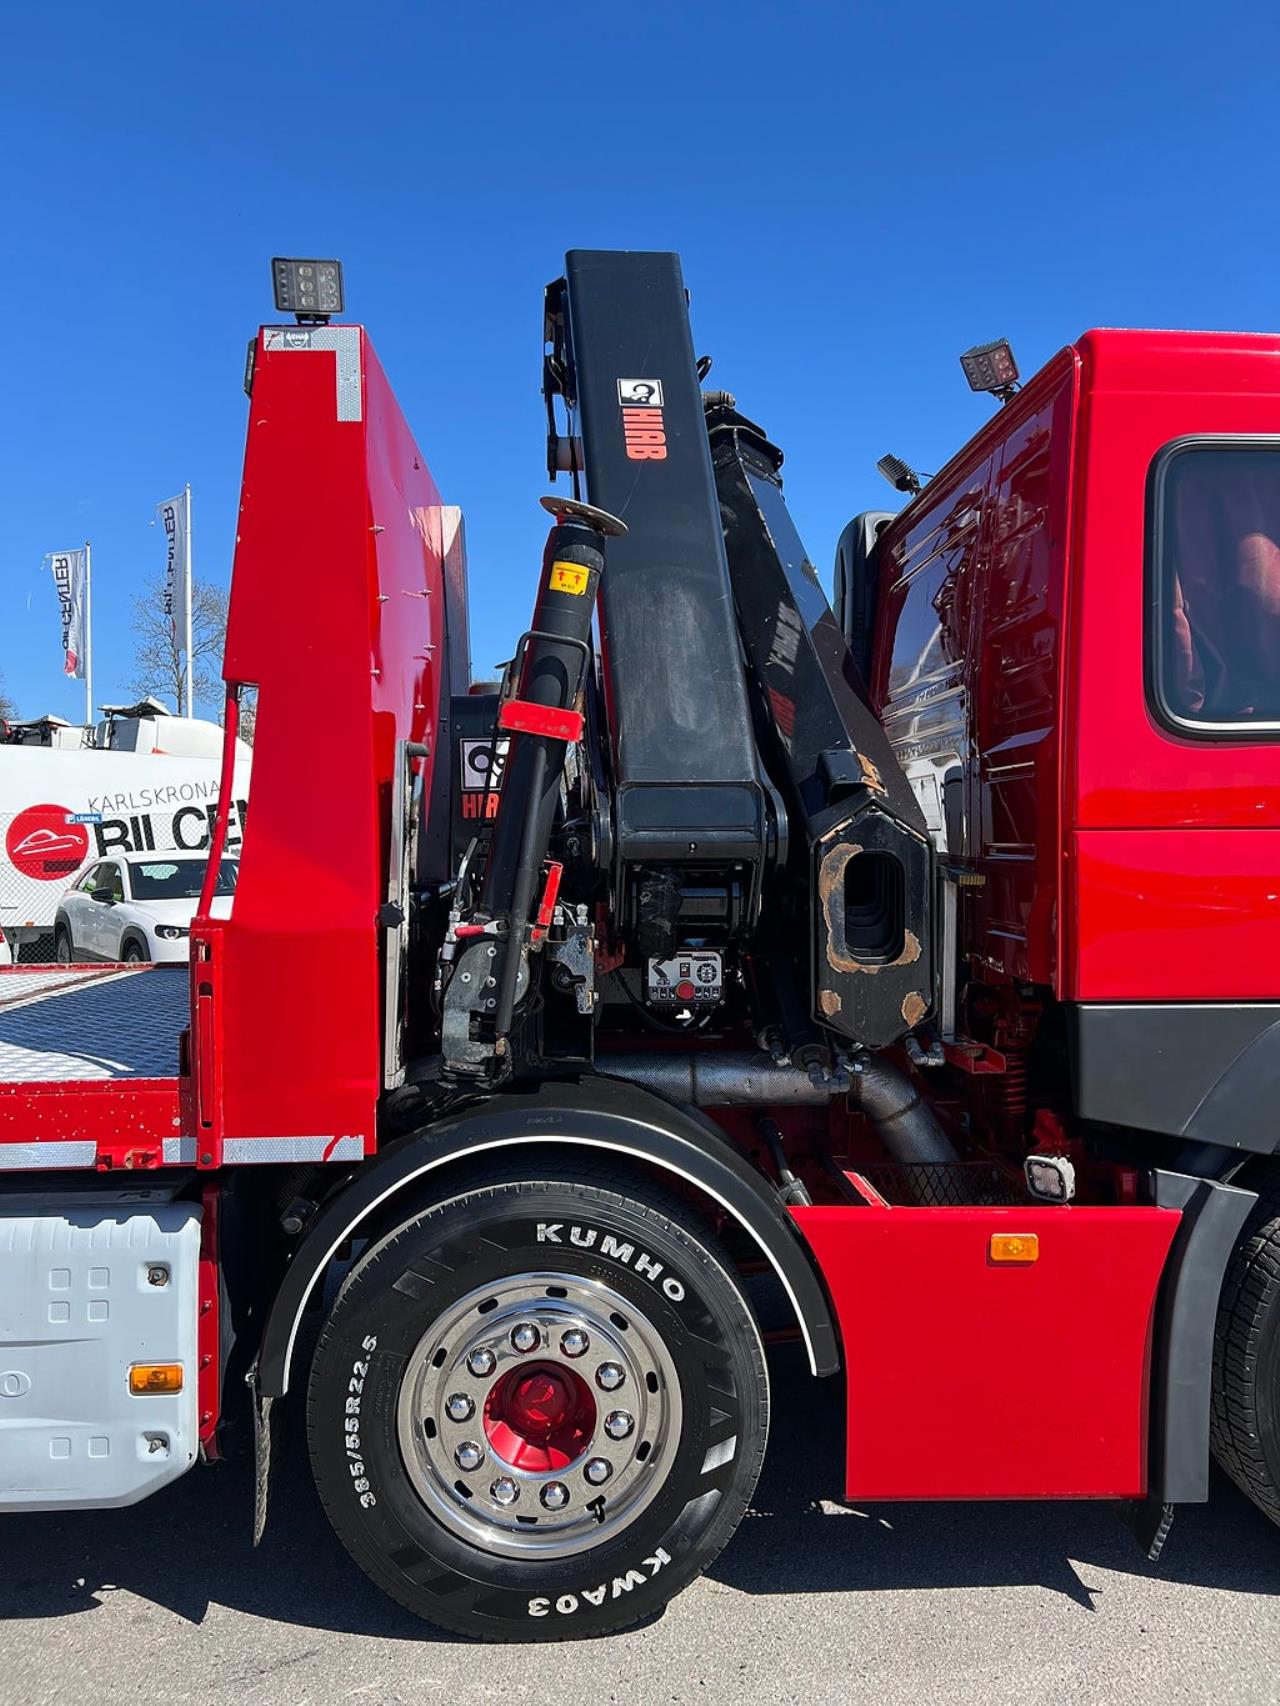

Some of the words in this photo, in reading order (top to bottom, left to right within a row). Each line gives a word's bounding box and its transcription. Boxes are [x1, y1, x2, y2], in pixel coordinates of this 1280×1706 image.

[622, 408, 667, 460] HIAB
[88, 780, 220, 814] KARLSKRONA
[536, 1222, 686, 1303] KUMHO
[344, 1334, 378, 1510] 385/55R22.5
[528, 1546, 672, 1617] KWA03
